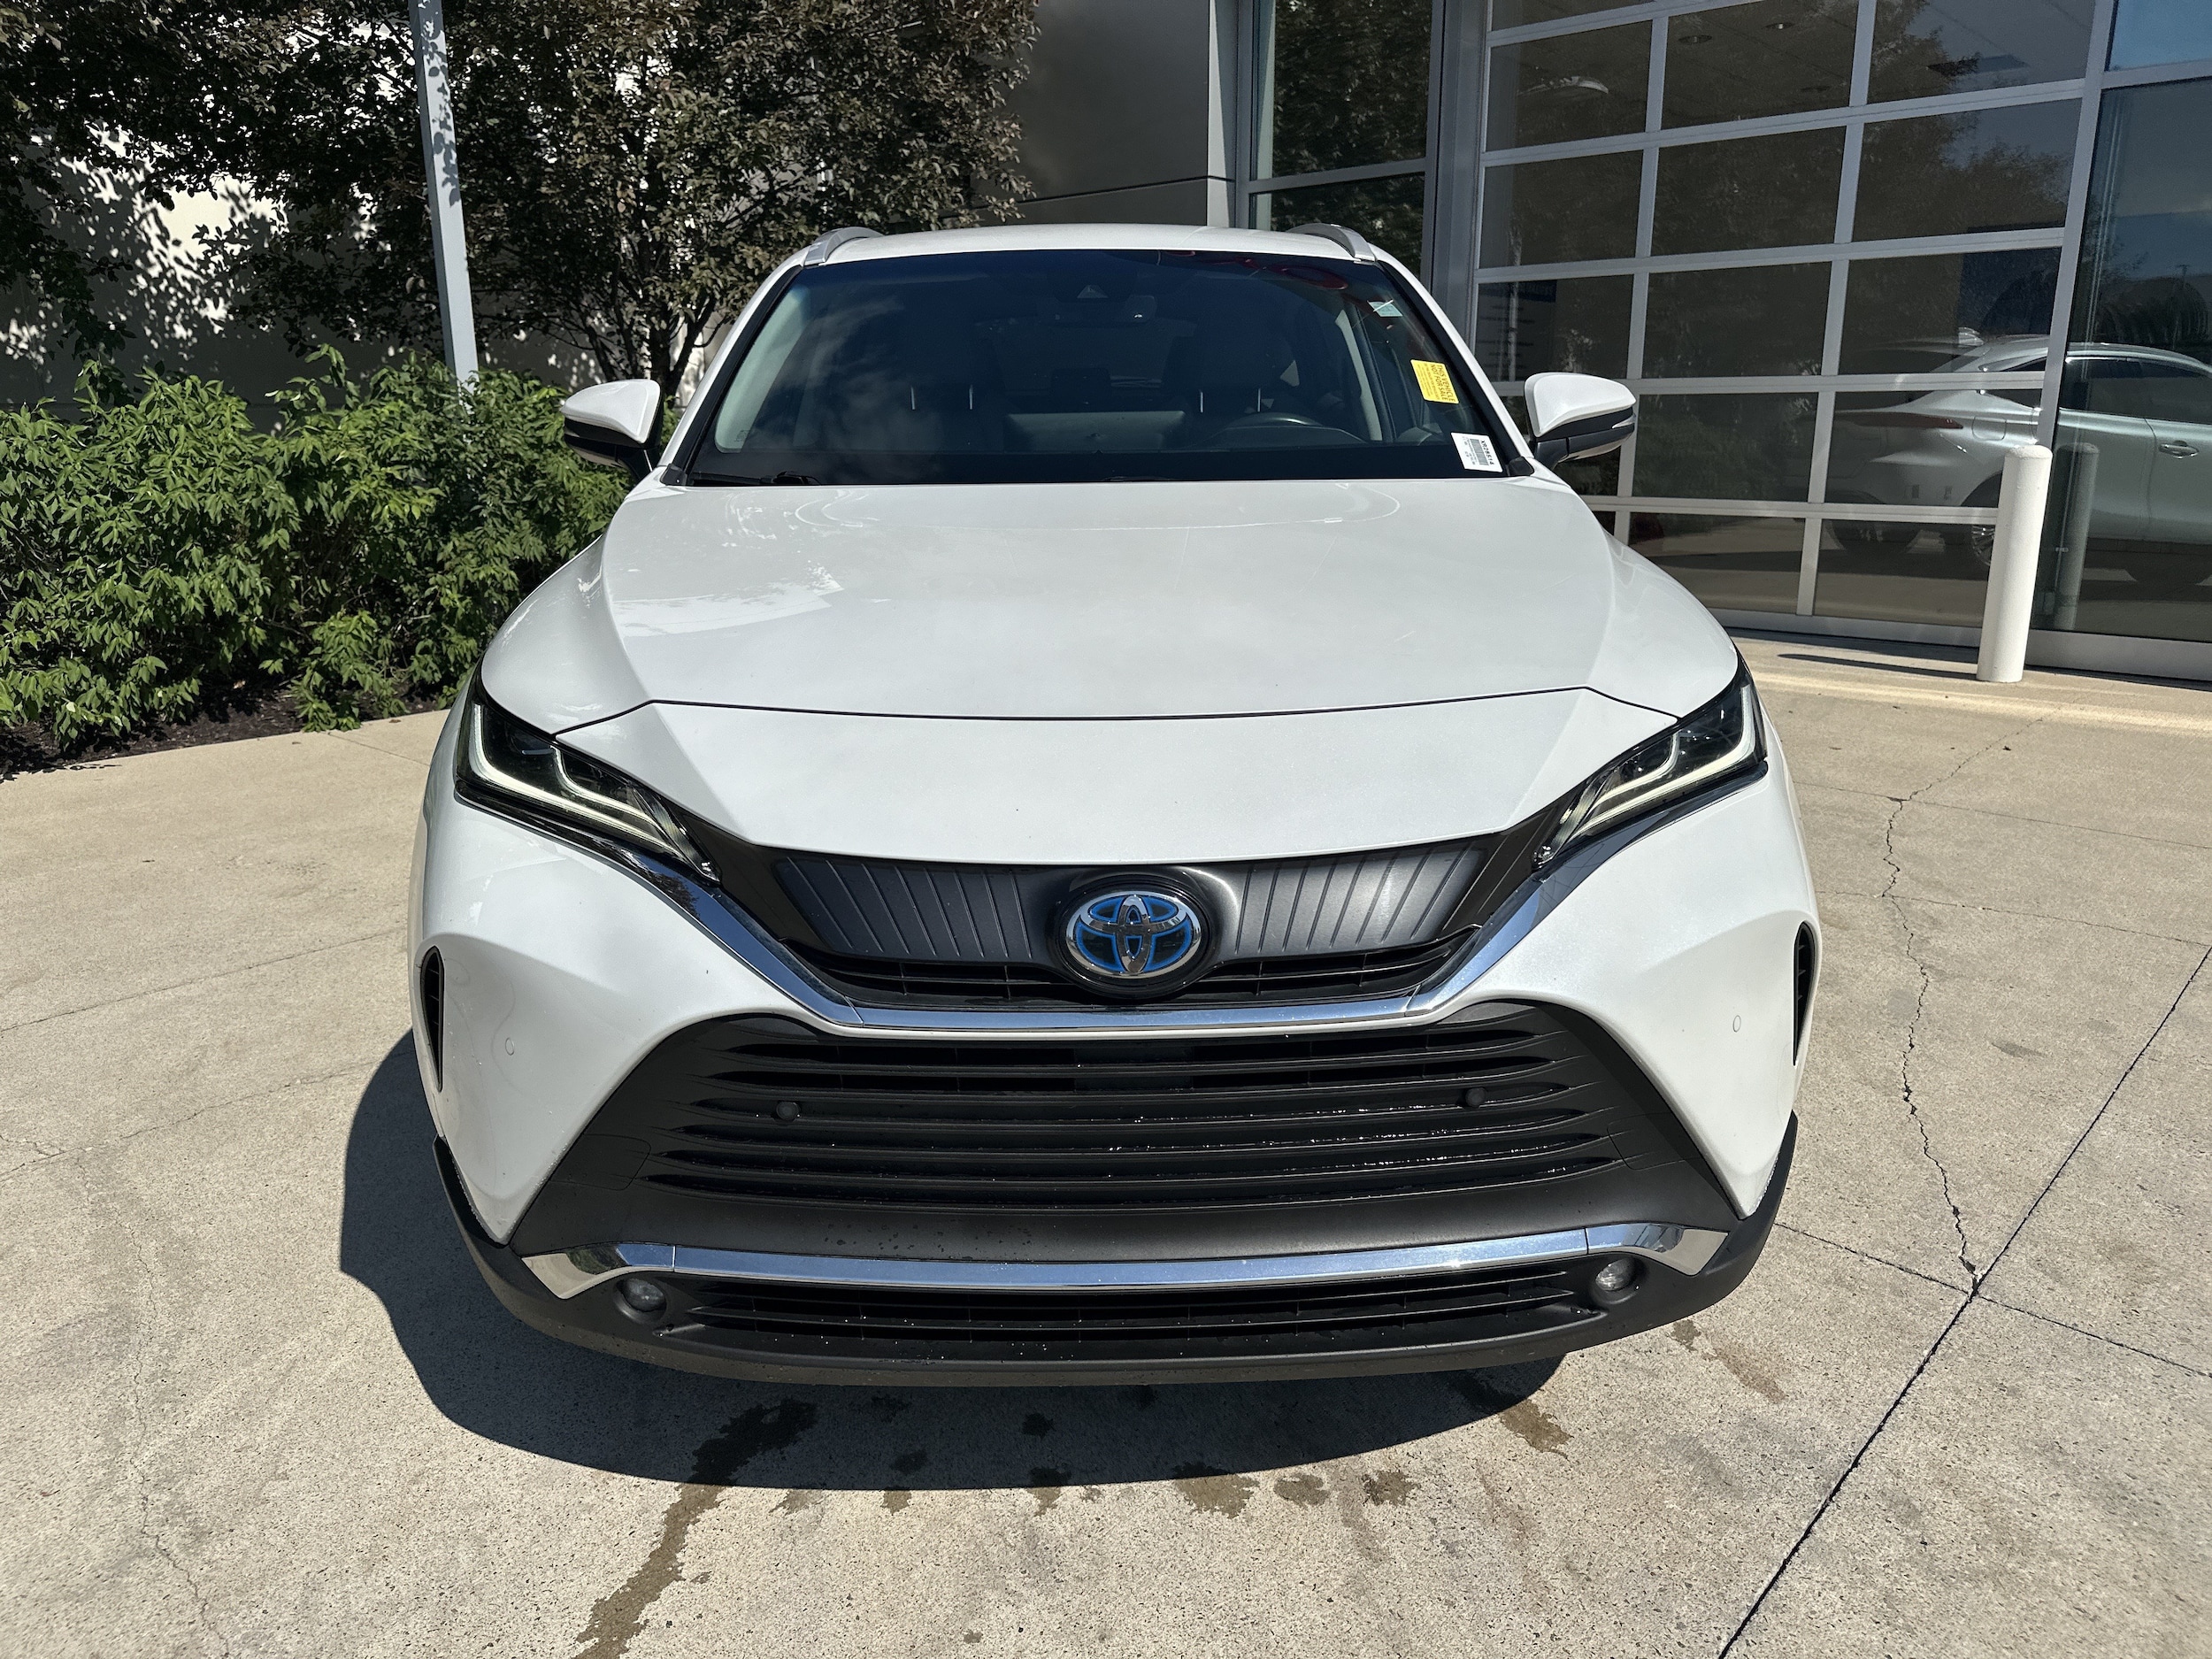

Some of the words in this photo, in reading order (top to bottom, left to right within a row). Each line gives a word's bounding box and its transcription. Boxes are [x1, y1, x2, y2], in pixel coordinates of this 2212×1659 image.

[1430, 364, 1440, 375] NOT
[1436, 365, 1447, 378] THIS
[1433, 375, 1443, 387] FOR
[1438, 387, 1448, 401] SALE
[1441, 378, 1456, 403] VEHICLE
